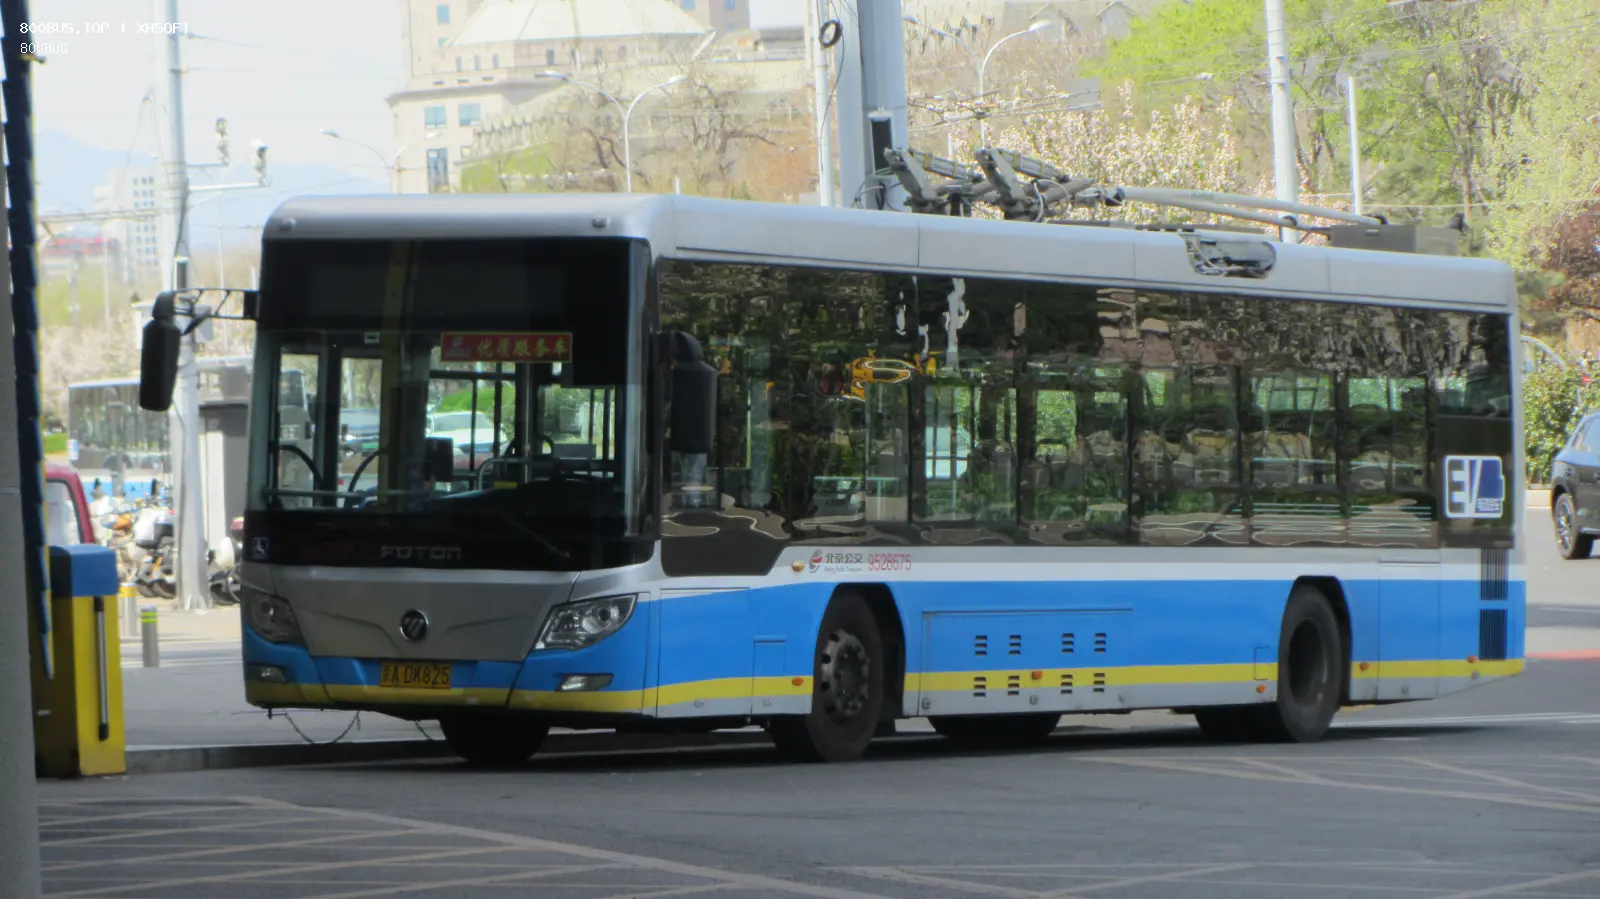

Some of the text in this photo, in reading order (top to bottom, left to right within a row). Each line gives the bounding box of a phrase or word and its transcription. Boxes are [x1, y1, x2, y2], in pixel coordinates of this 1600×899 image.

[381, 545, 461, 560] FOTON
[825, 552, 863, 564] 北京公交
[868, 553, 912, 571] 9528675
